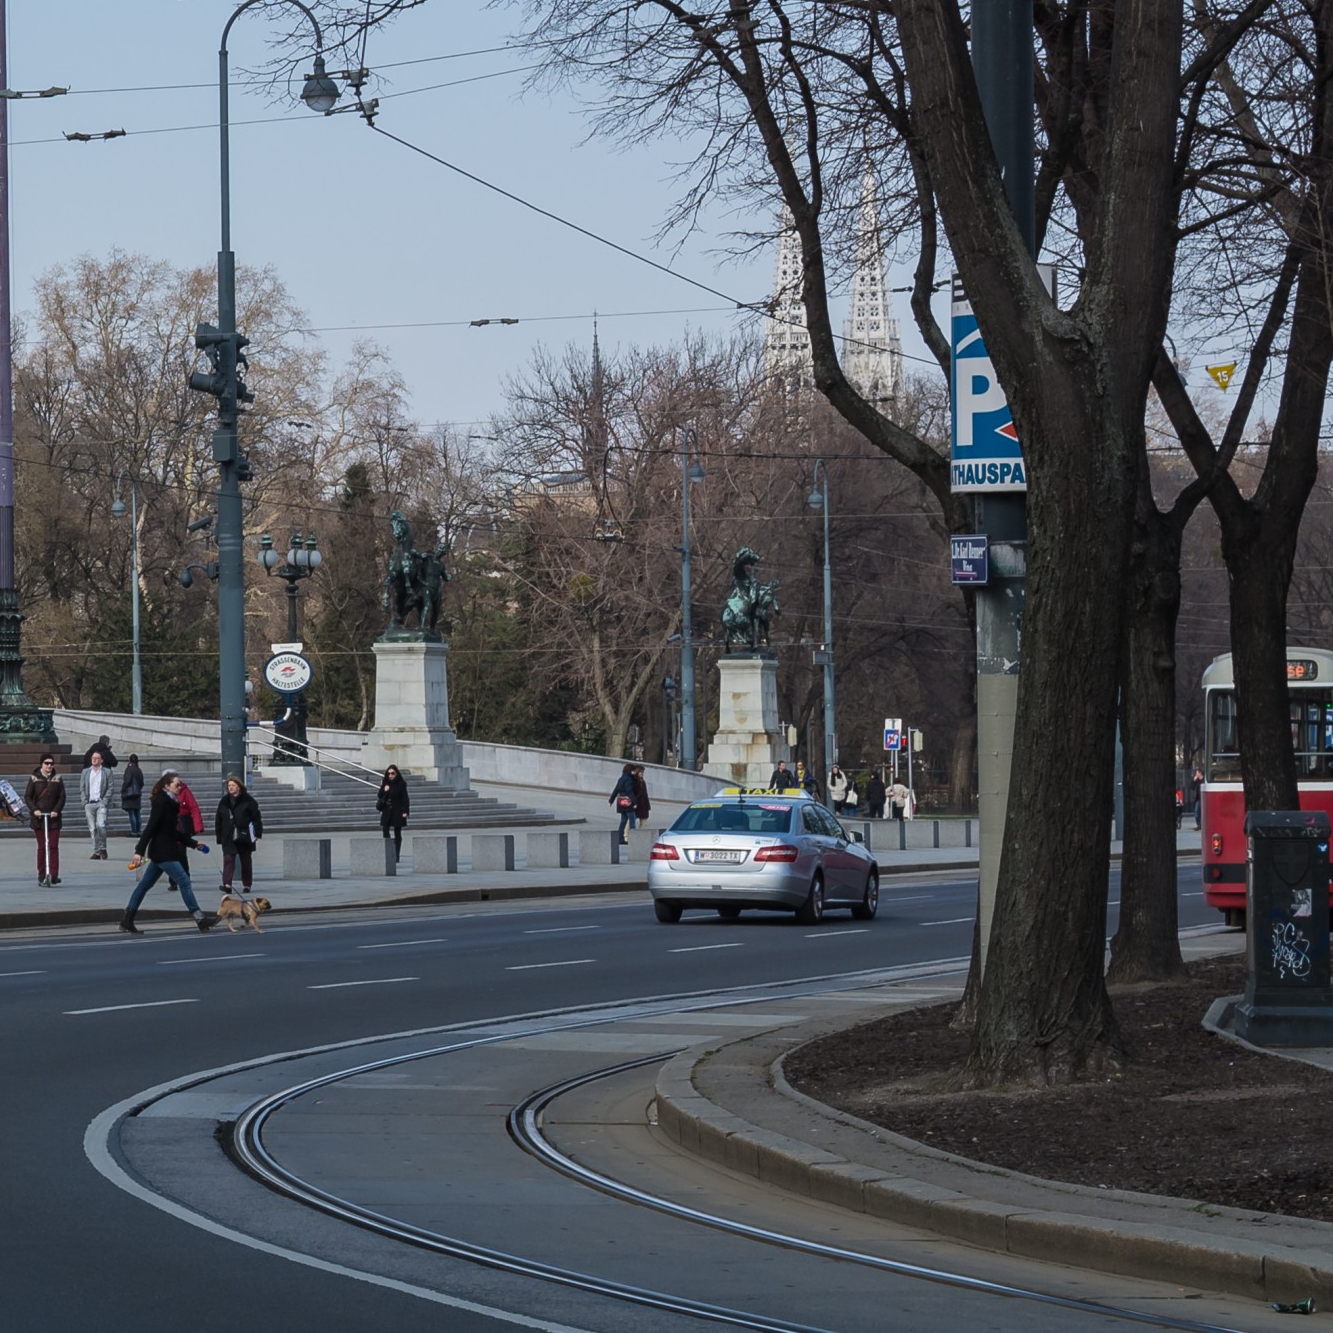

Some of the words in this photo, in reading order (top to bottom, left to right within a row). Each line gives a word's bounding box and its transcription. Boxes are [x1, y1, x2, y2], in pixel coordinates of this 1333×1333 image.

[1217, 370, 1229, 383] 15
[270, 657, 307, 670] STRASSENBAHN
[272, 677, 305, 688] HALTESTELLE
